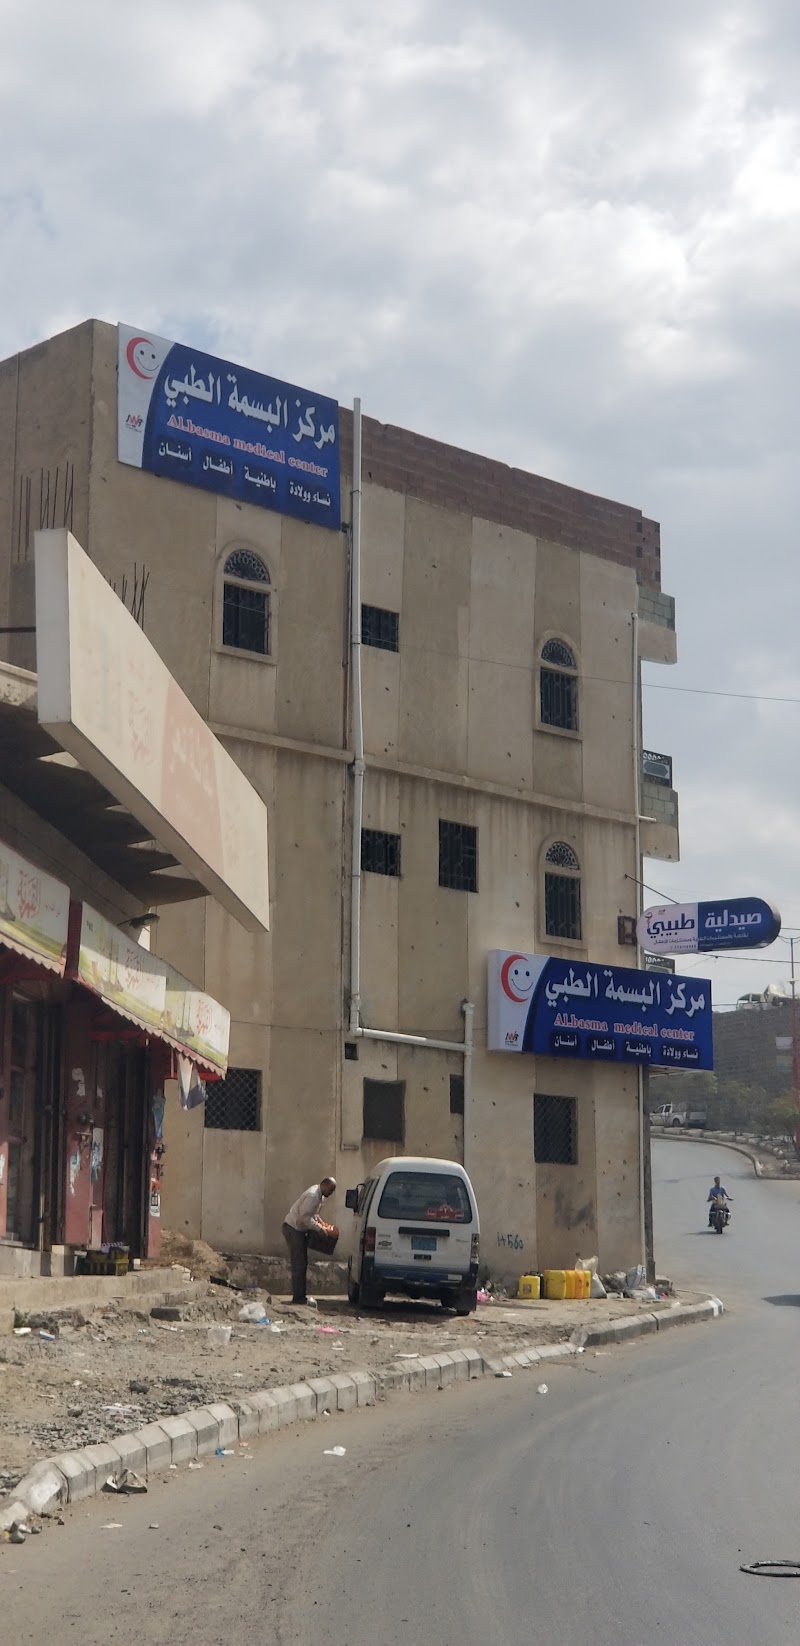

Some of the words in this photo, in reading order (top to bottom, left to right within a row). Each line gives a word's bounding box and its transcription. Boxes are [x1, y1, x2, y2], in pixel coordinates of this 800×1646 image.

[164, 364, 221, 408] الطبي
[226, 373, 288, 433] البسمة
[292, 399, 336, 449] مركز
[158, 442, 192, 461] أسنان
[233, 438, 286, 464] medical
[287, 456, 329, 478] center
[203, 455, 233, 475] أطفال
[244, 466, 277, 492] باطنية
[312, 492, 331, 507] نساء
[646, 913, 695, 939] طبيبي
[705, 909, 762, 933] صيدلية
[545, 968, 598, 1007] الطبي
[603, 969, 661, 1012] البسمة
[665, 979, 706, 1017] مركز
[554, 1035, 578, 1047] أسنان
[613, 1021, 658, 1037] medical
[660, 1027, 695, 1041] center
[591, 1039, 615, 1051] أطفال
[626, 1041, 652, 1057] باطنية
[682, 1048, 698, 1059] نساء
